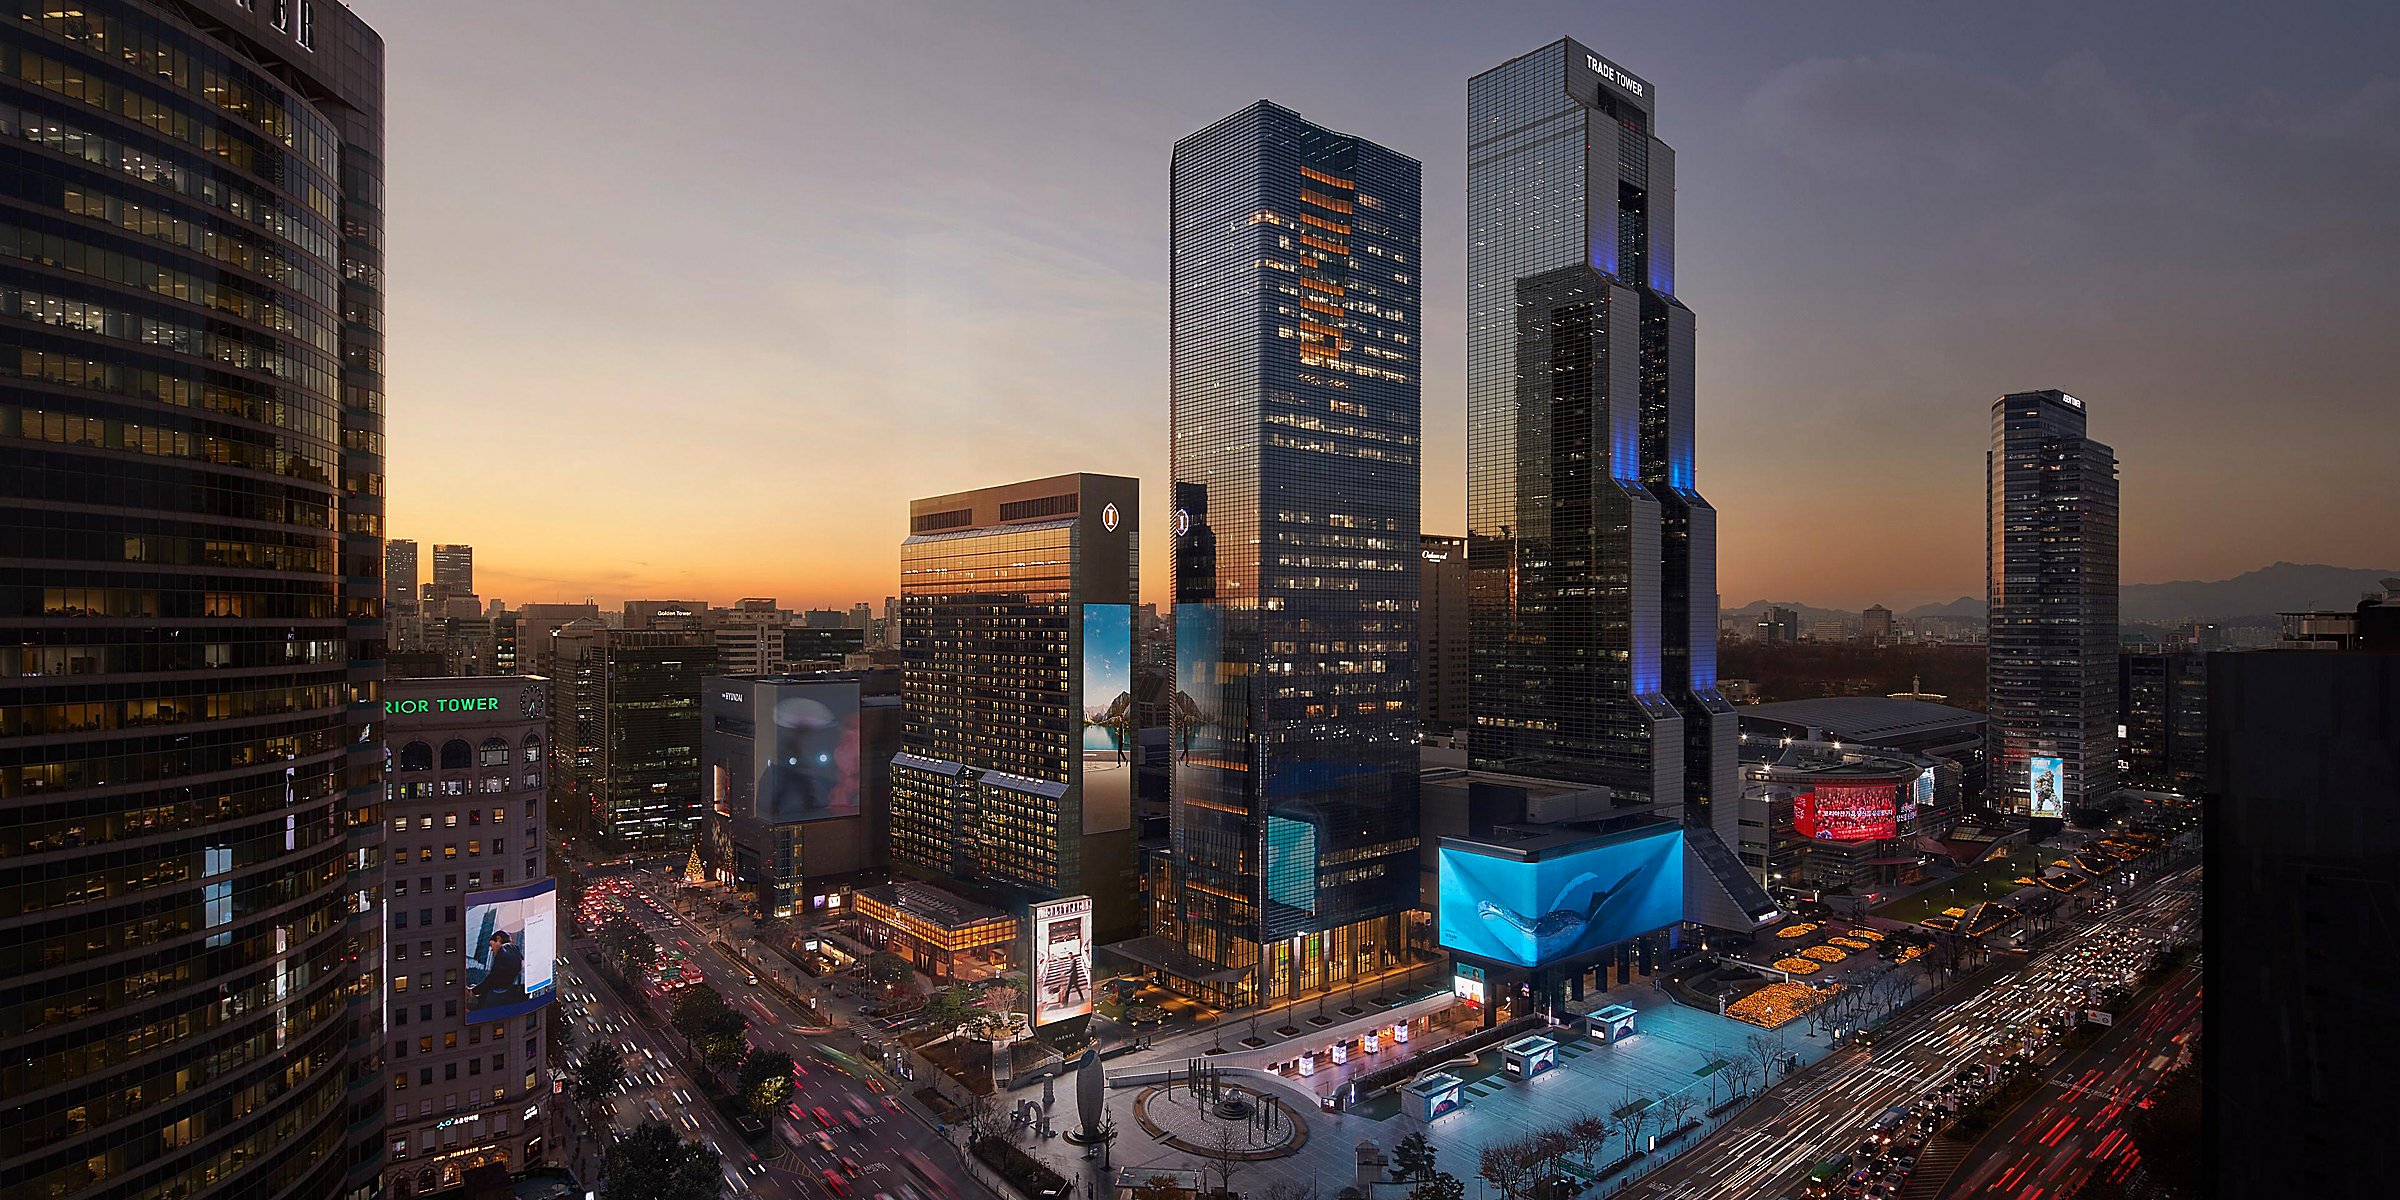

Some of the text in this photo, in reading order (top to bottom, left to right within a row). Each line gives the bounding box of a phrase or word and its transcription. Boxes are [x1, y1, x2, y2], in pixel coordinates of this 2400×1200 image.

[1586, 54, 1643, 97] TRADE TOWER
[437, 698, 499, 712] TOWER
[1055, 1032, 1075, 1041] PARNAS
